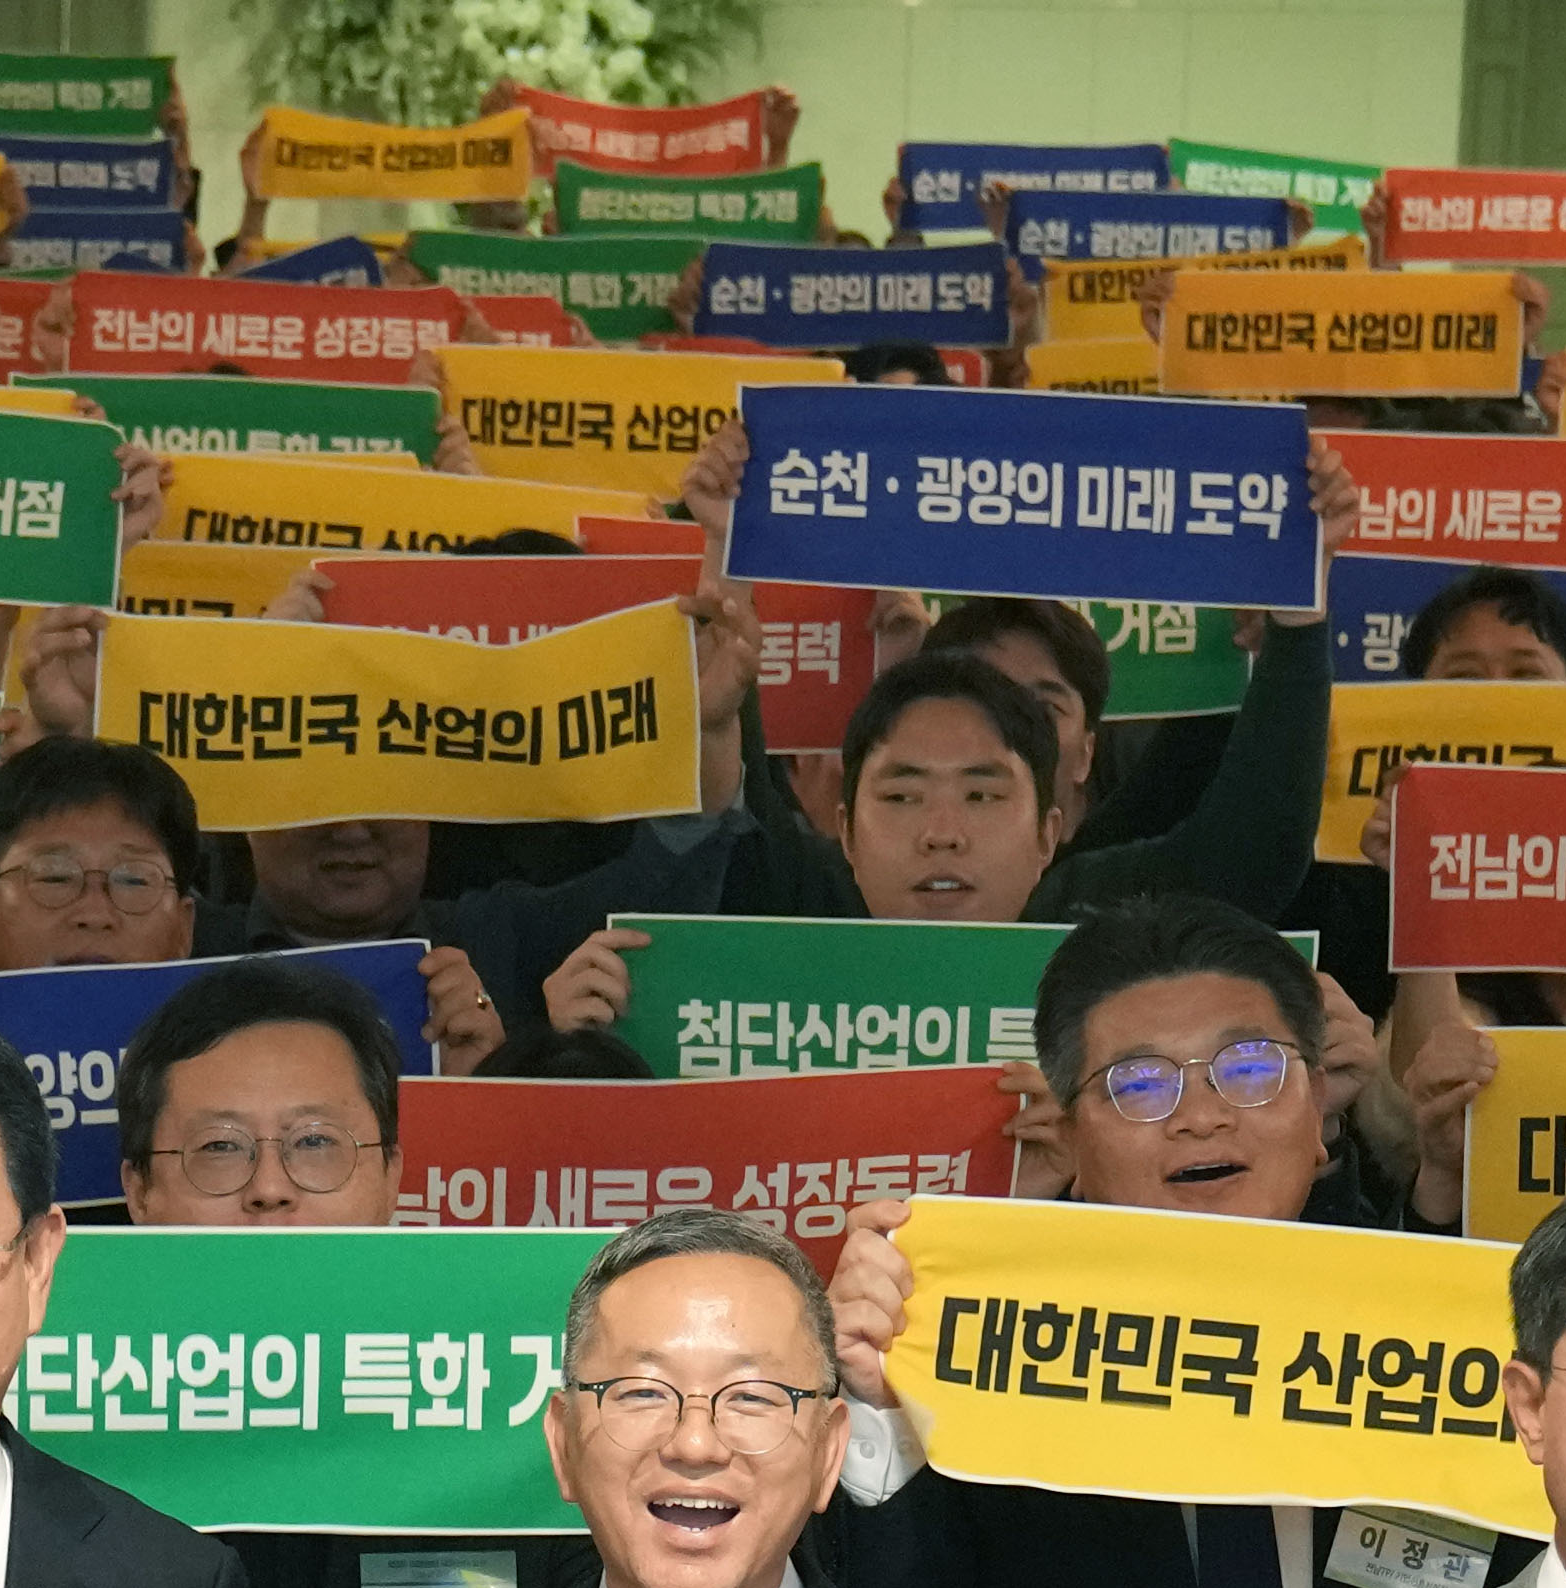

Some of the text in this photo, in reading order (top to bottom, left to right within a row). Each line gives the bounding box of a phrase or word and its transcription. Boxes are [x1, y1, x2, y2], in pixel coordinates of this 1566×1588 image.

[711, 276, 765, 313] 순천
[790, 275, 871, 313] 광양의
[93, 308, 194, 353] 전남의
[202, 314, 304, 359] 새로운
[1186, 313, 1497, 352] 대한민국 산업의 미래
[462, 398, 614, 449] 대한민국
[770, 449, 1288, 539] 순천 광양의 미래 도약
[1350, 488, 1435, 541] 남의
[1444, 491, 1562, 543] 새로운
[136, 677, 657, 765] 대한민국 산업의 미래
[8, 1333, 489, 1431] 단산업의 특화
[936, 1297, 1259, 1415] 대한민국
